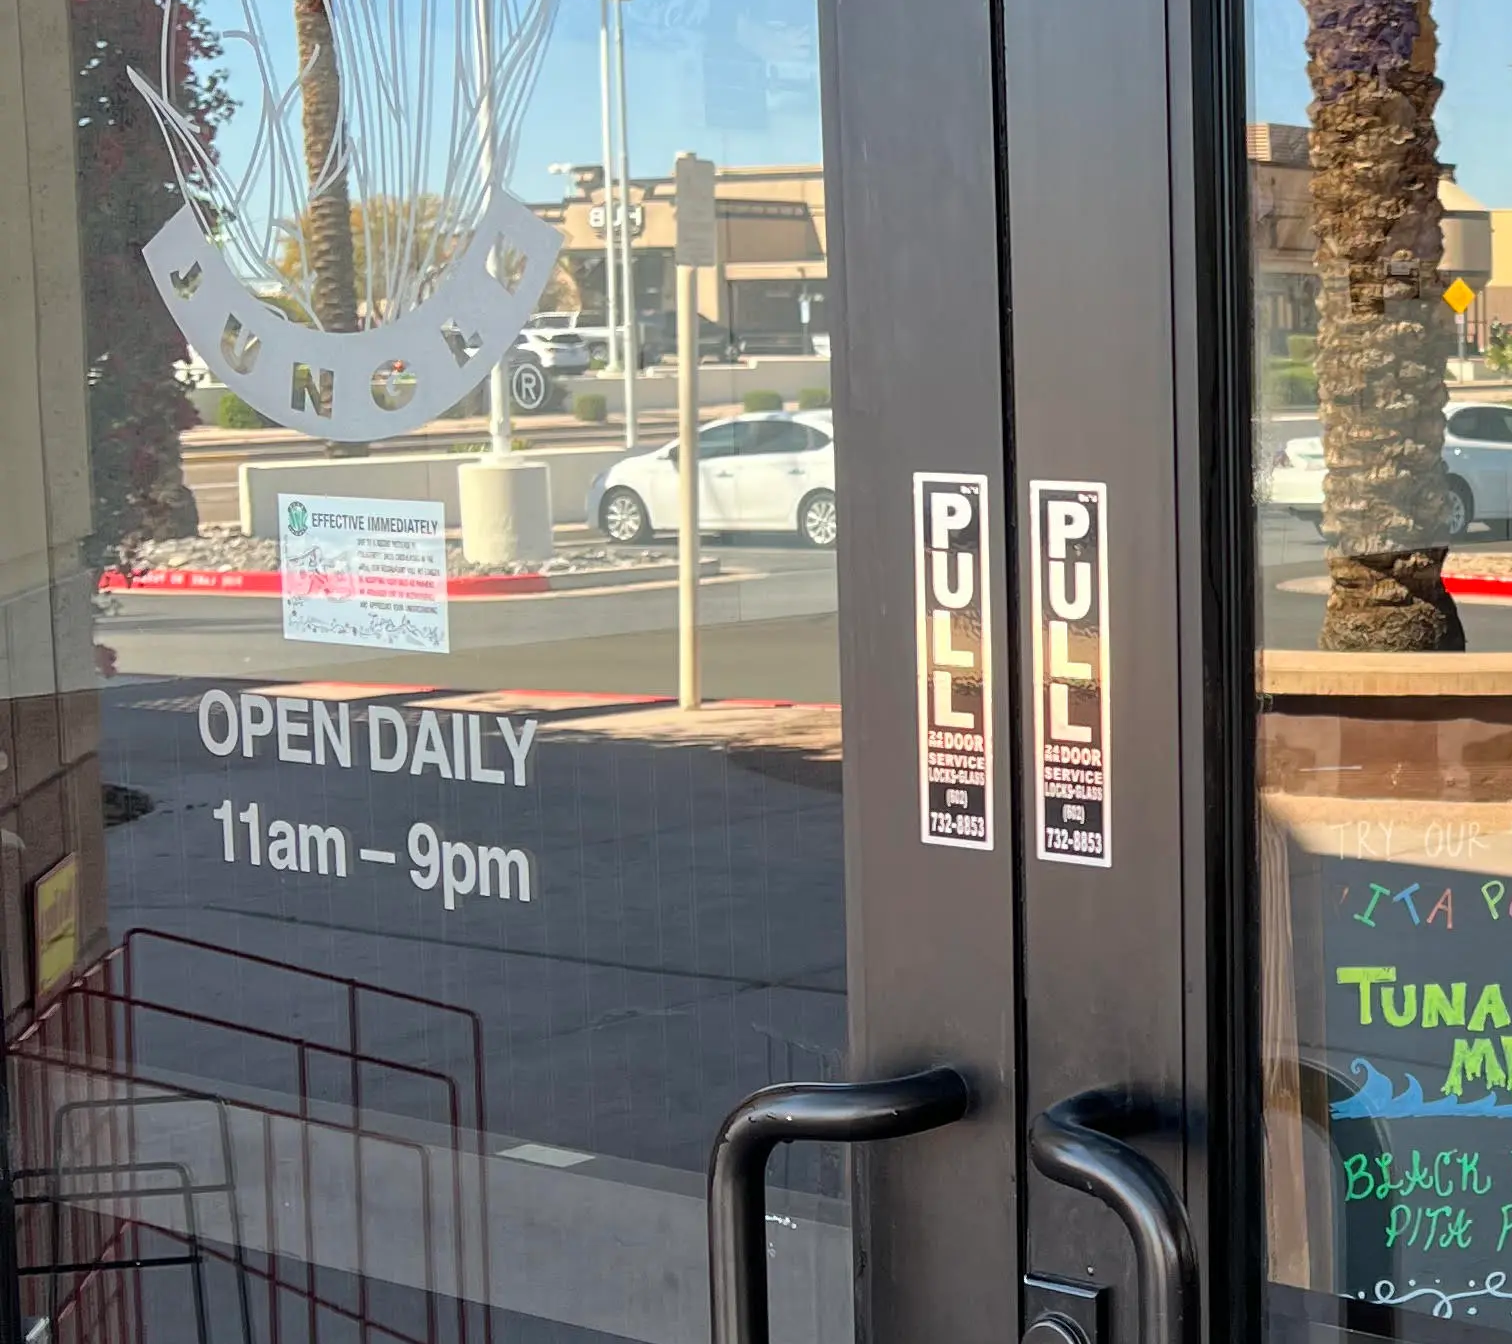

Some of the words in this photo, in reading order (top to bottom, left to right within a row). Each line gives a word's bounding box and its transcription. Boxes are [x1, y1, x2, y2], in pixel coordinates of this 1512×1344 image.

[169, 231, 528, 418] JUNGLE
[312, 513, 364, 531] EFFECTIVE
[367, 517, 438, 535] IMMEDIATELY
[930, 492, 975, 729] PULL
[1048, 500, 1093, 743] PULL
[198, 689, 352, 768] OPEN
[368, 704, 538, 787] DAILY
[928, 752, 985, 770] SERVICE
[944, 732, 984, 752] DOOR
[1061, 746, 1102, 766] DOOR
[1045, 766, 1103, 785] SERVICE
[214, 799, 347, 877] 11am
[408, 823, 531, 911] 9pm
[1329, 819, 1395, 861] TRY
[1425, 820, 1490, 859] OUR
[1333, 882, 1454, 930] ITA
[1336, 966, 1511, 1032] TUNA
[1344, 1148, 1493, 1203] BLACK
[1385, 1204, 1474, 1250] PITA
